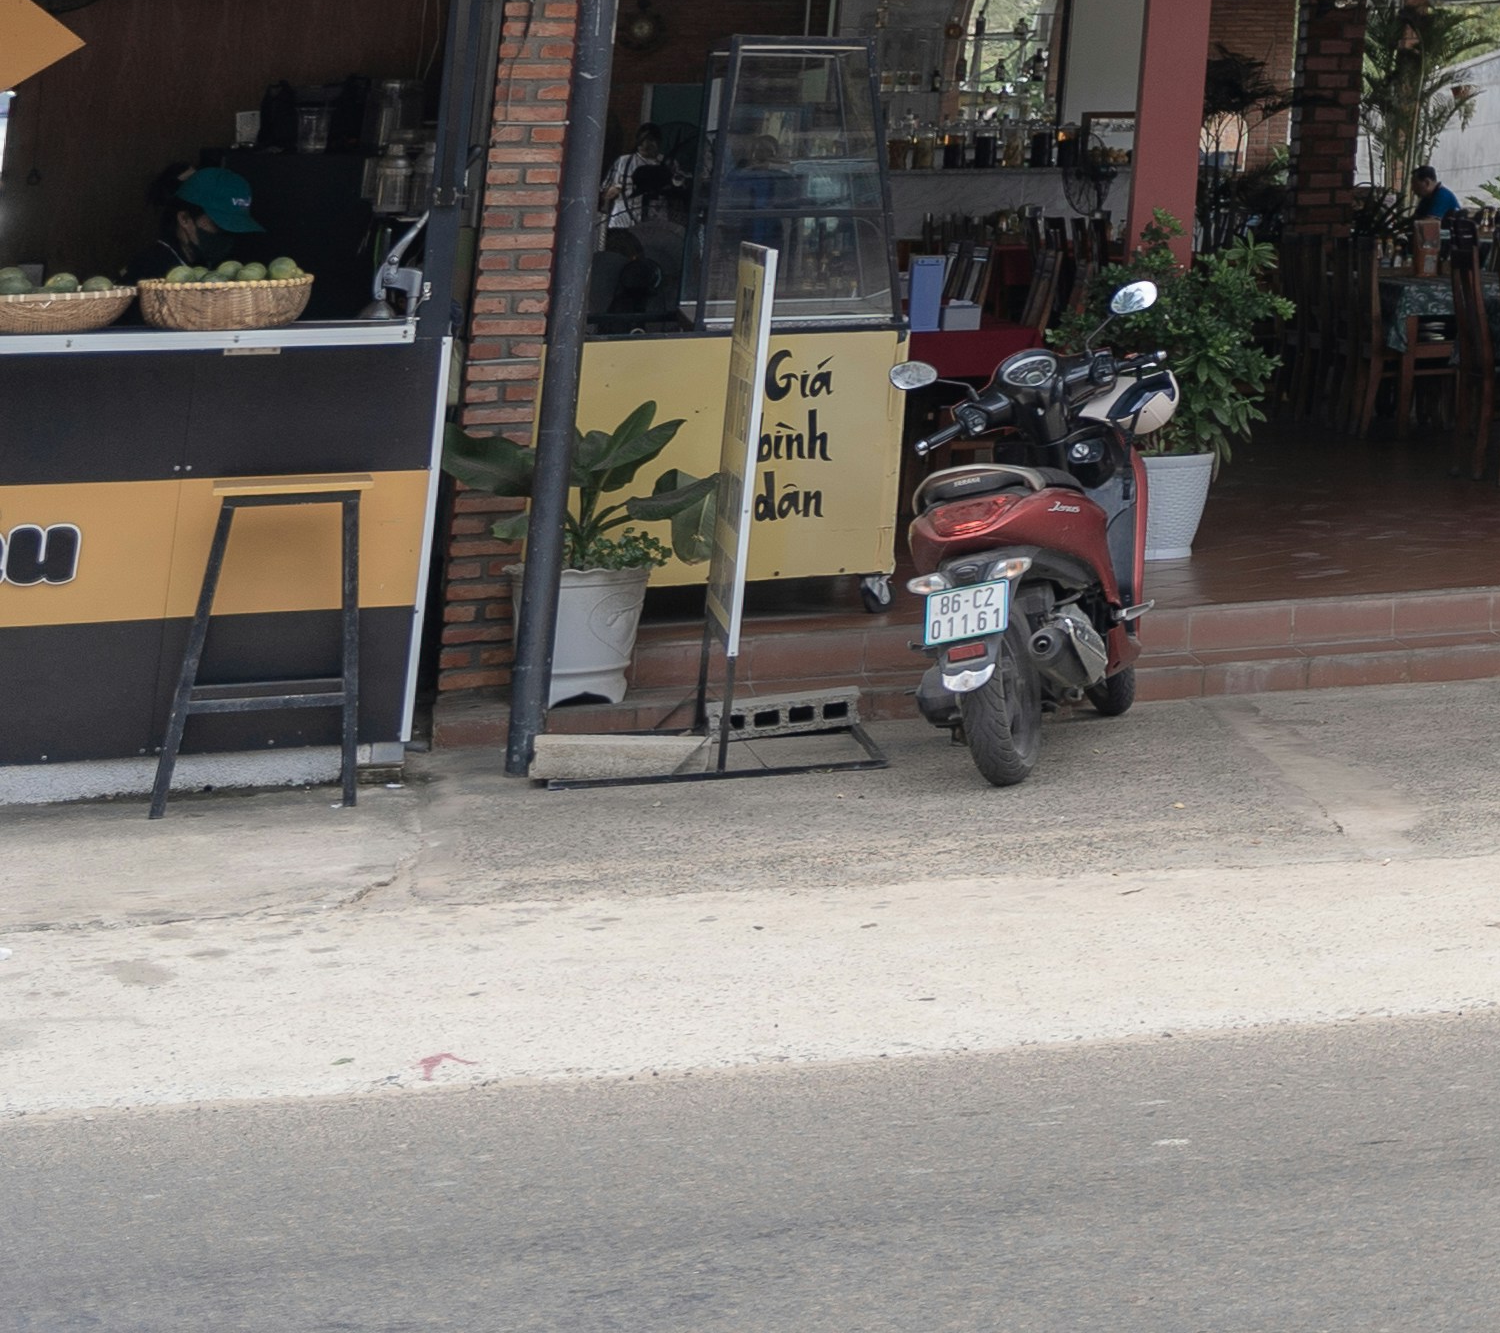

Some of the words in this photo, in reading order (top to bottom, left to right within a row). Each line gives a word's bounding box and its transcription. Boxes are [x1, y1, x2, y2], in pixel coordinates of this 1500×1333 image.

[765, 348, 835, 402] Giá
[756, 409, 833, 463] bình
[754, 470, 824, 522] dân
[930, 607, 1001, 641] 011.61
[940, 586, 994, 616] 86-C2
